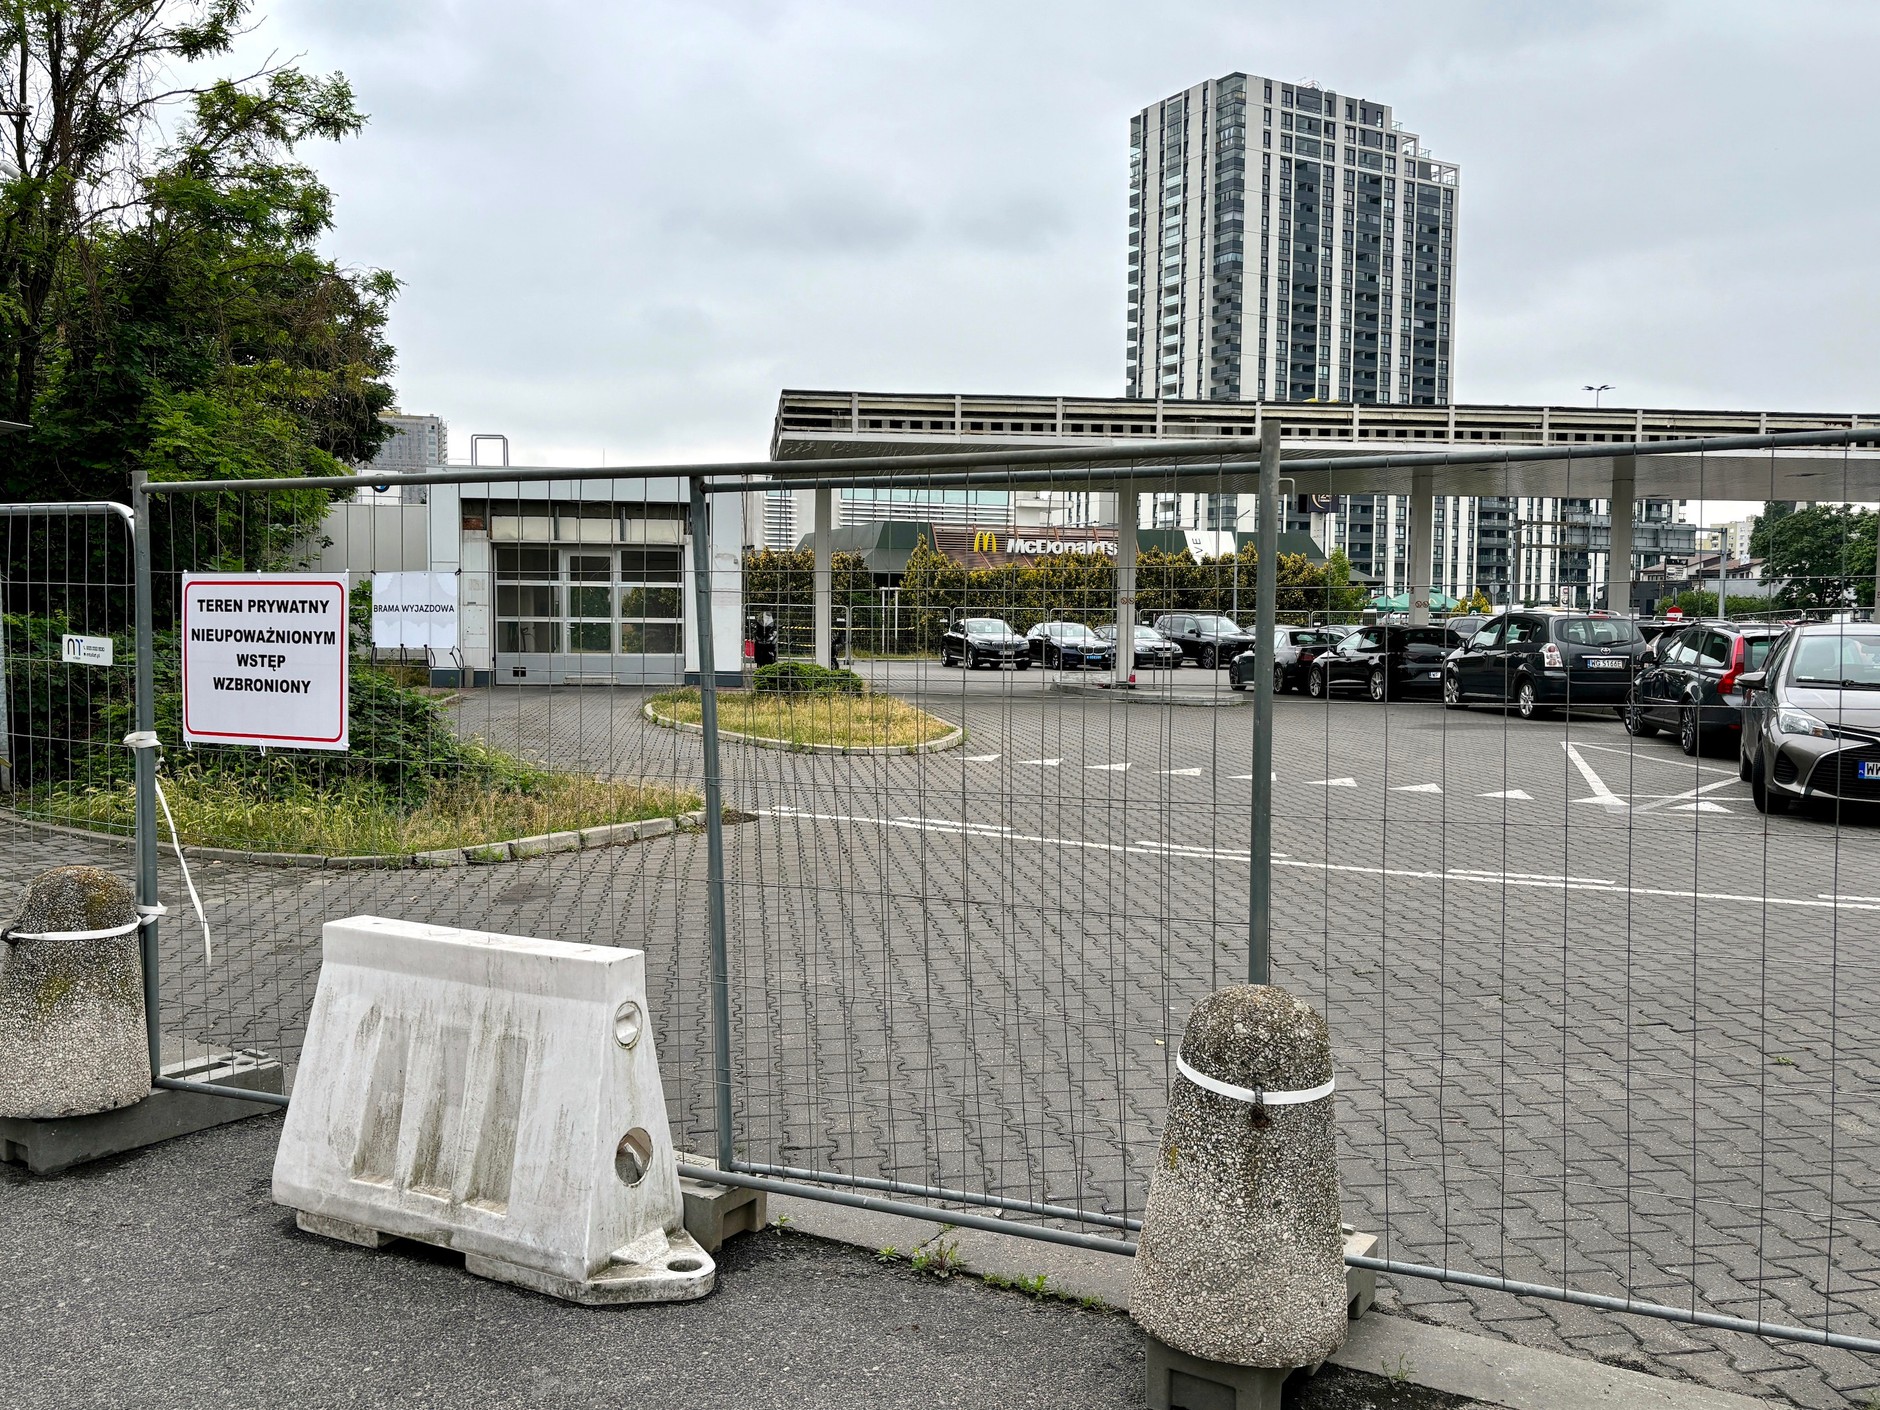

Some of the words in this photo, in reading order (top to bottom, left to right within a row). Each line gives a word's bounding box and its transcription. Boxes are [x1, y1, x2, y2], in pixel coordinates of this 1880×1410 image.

[1007, 538, 1118, 555] McDonald's
[197, 599, 243, 613] TEREN
[248, 599, 330, 614] PRYWATNY
[373, 604, 400, 613] BRAMA
[401, 604, 455, 613] WYJAZDOWA
[191, 627, 336, 645] NIEUPOWAŻNIONYM
[236, 653, 286, 672] WSTĘP
[213, 677, 311, 694] WZBRONIONY
